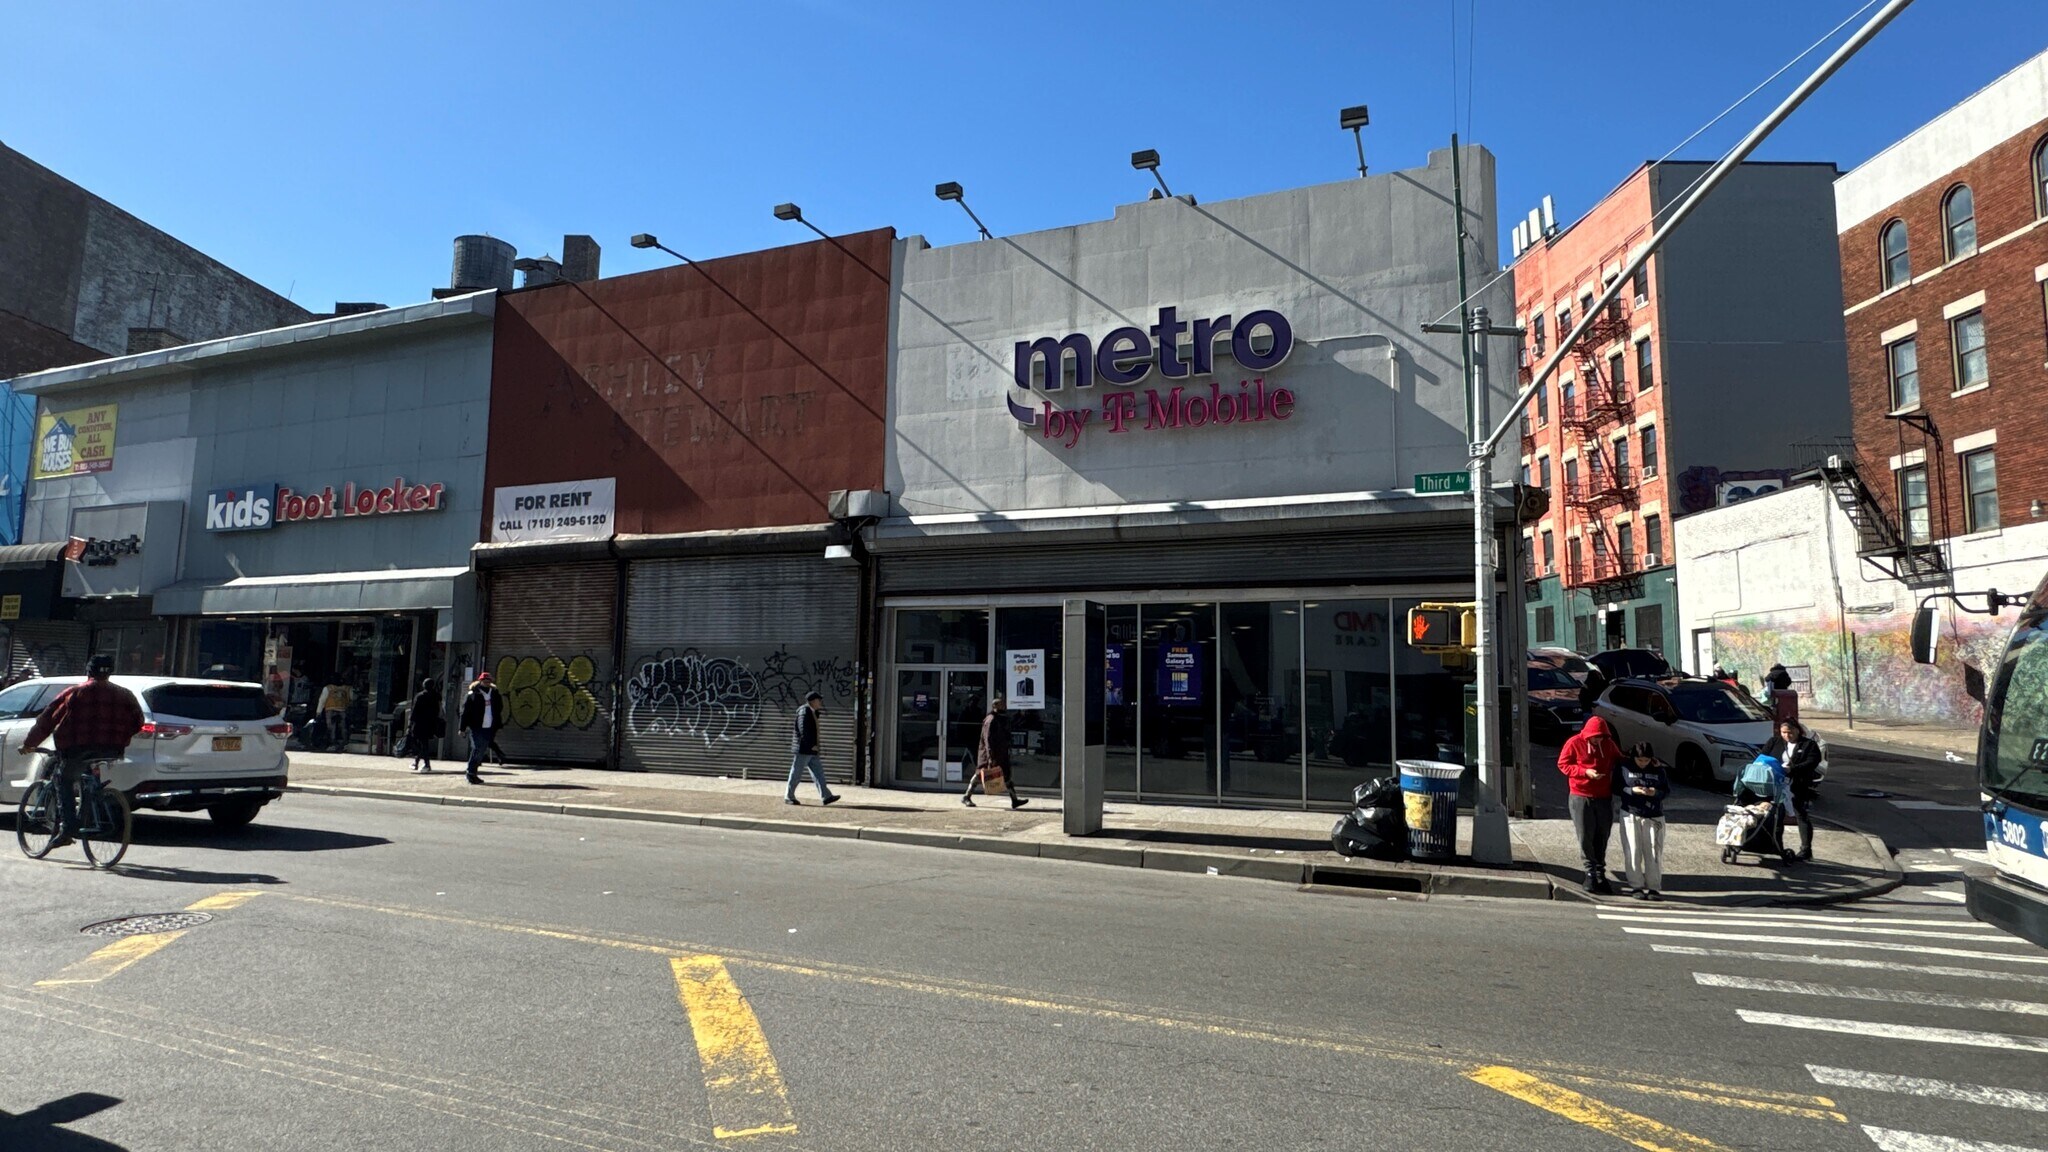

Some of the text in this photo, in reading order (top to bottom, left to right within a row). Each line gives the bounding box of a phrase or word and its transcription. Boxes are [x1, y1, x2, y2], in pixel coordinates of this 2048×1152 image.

[1013, 305, 1295, 392] metro
[86, 410, 107, 424] ANY
[1042, 401, 1092, 449] by
[1144, 378, 1296, 431] Mobile
[44, 436, 58, 453] WE
[86, 433, 101, 444] ALL
[41, 450, 73, 472] HOUSES
[80, 445, 106, 459] CASH
[1421, 474, 1466, 491] Third Av
[206, 477, 444, 530] kids Foot Locker
[515, 491, 593, 511] FOR RENT
[499, 514, 607, 531] CALL (718) 249-6120
[2002, 819, 2028, 850] 5802
